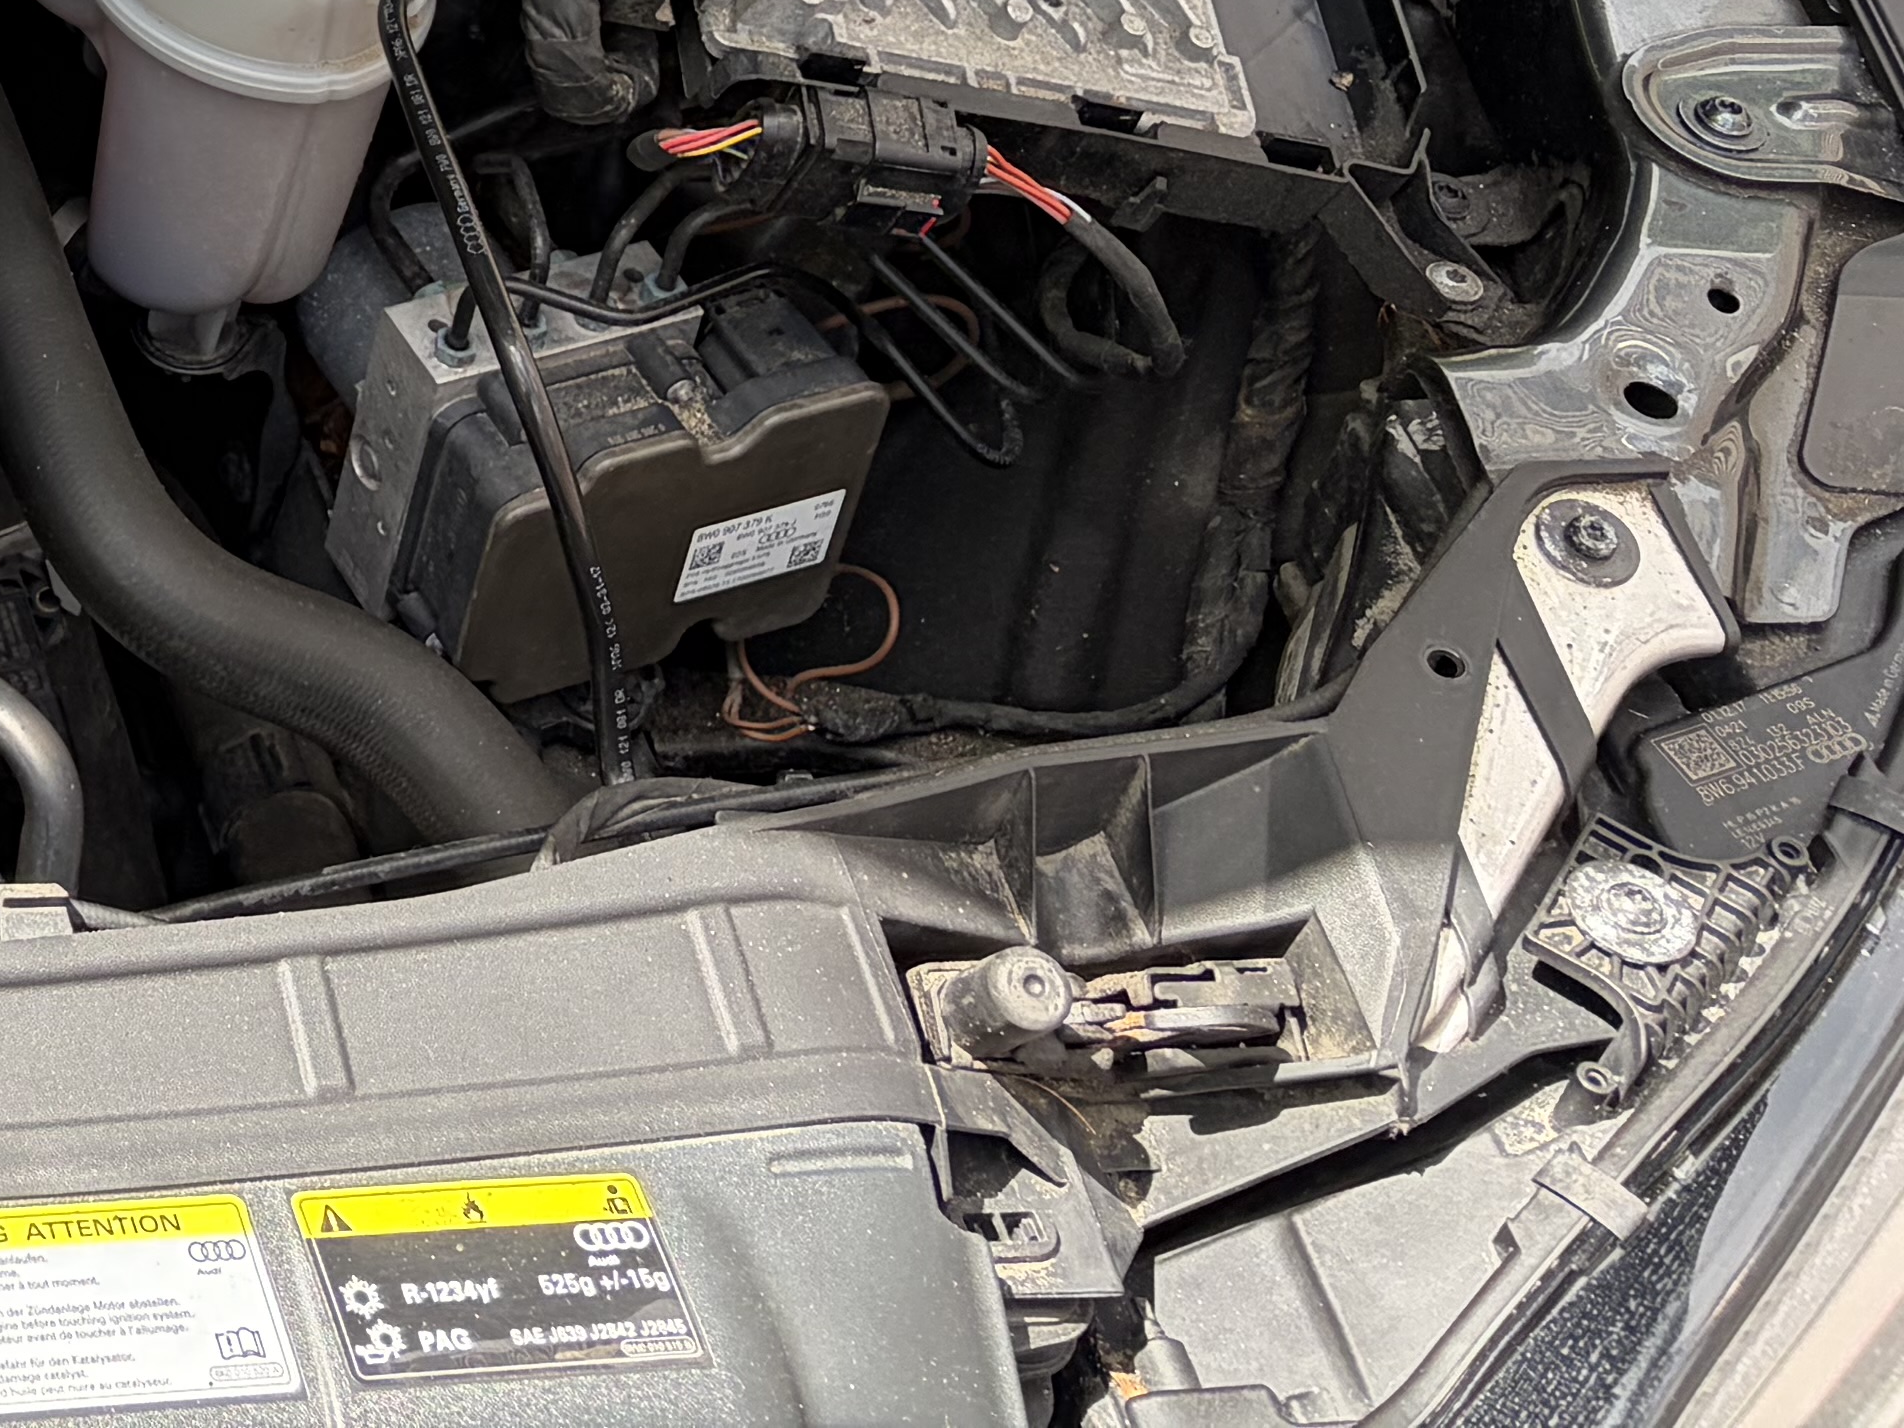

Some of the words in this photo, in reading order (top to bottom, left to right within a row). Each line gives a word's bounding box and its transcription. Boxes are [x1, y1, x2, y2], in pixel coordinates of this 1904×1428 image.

[445, 174, 470, 213] Germany
[722, 523, 742, 537] 907
[742, 517, 763, 531] 379
[764, 515, 773, 524] K
[615, 687, 626, 703] DR
[1870, 687, 1891, 715] Made
[1806, 708, 1836, 726] ALN
[619, 734, 630, 755] 121
[1740, 716, 1853, 768] 030256323103
[25, 1213, 182, 1241] ATTENTION
[400, 1277, 501, 1304] R-1234yf
[538, 1273, 597, 1297] 525g
[600, 1268, 671, 1293] +/-15g
[417, 1327, 473, 1353] PAG
[509, 1326, 547, 1346] SAE
[549, 1325, 588, 1344] J639
